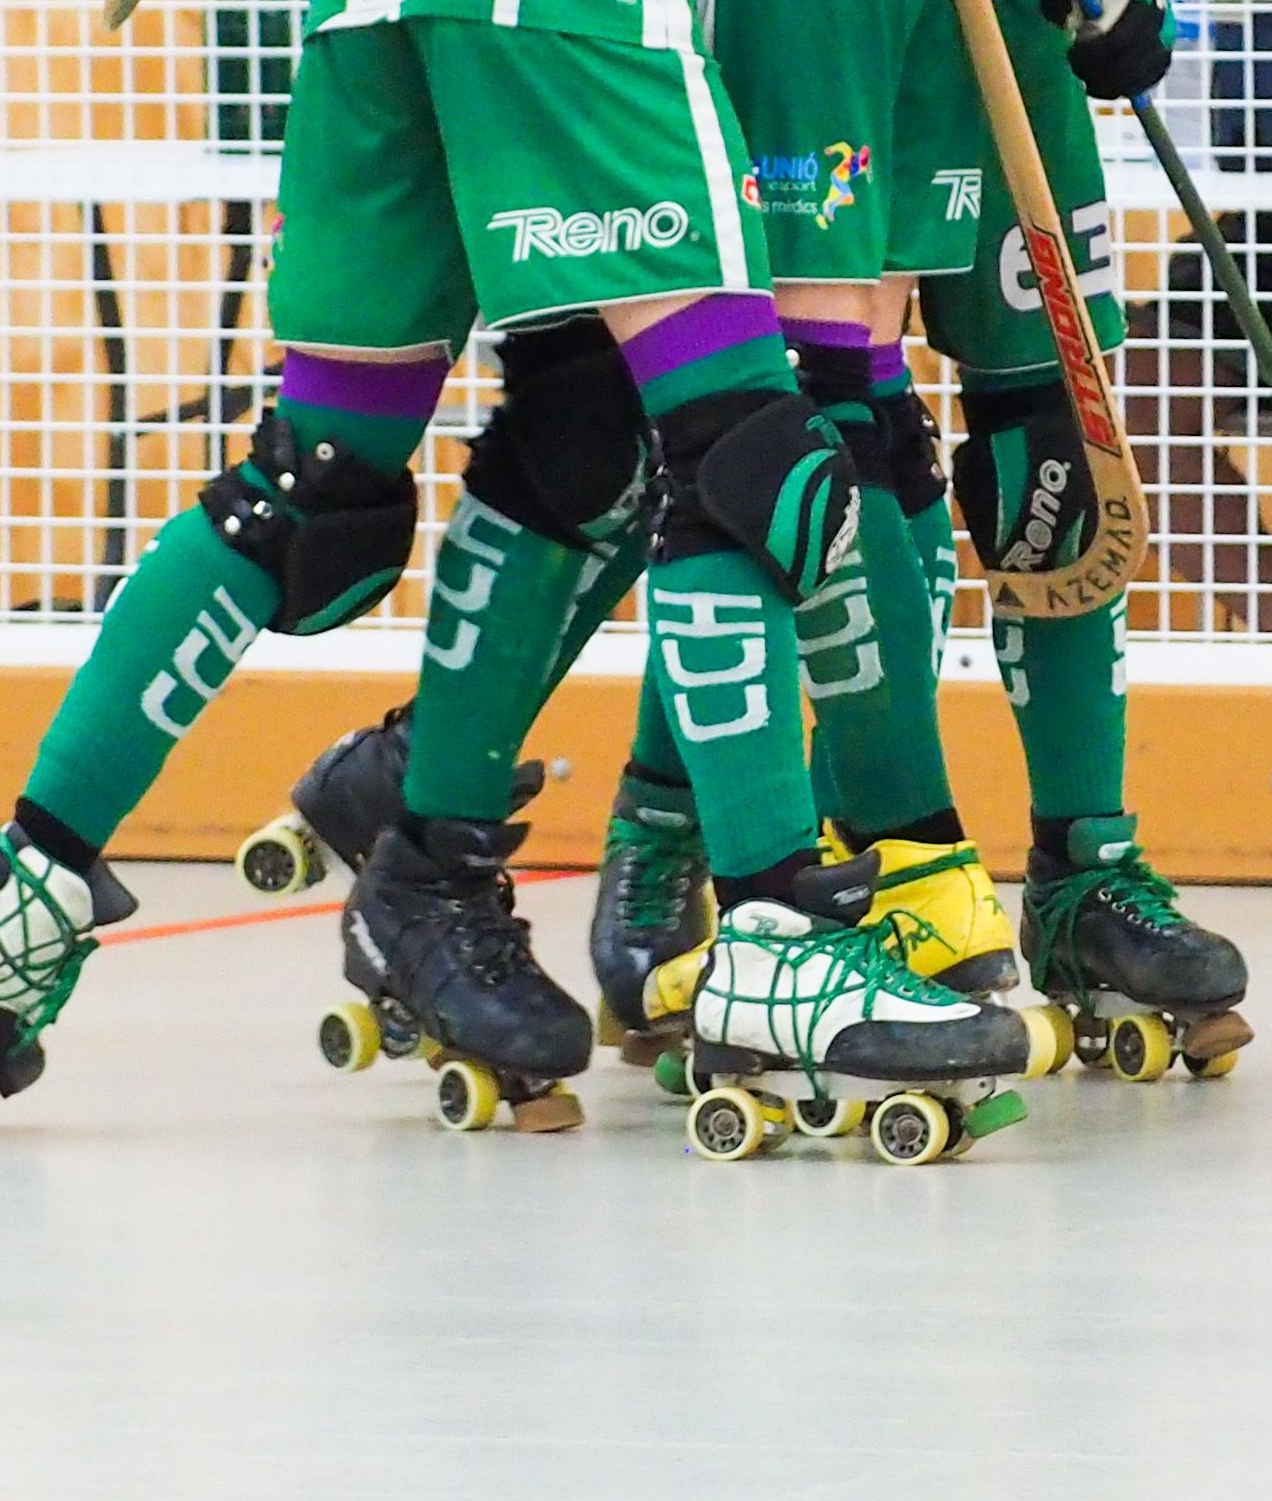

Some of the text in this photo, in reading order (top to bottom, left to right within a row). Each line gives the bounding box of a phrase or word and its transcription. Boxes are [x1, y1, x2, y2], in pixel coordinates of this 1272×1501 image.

[486, 201, 690, 263] Reno
[1027, 226, 1119, 451] STRONG
[1046, 496, 1133, 610] AZEMAD
[653, 587, 772, 743] CCH
